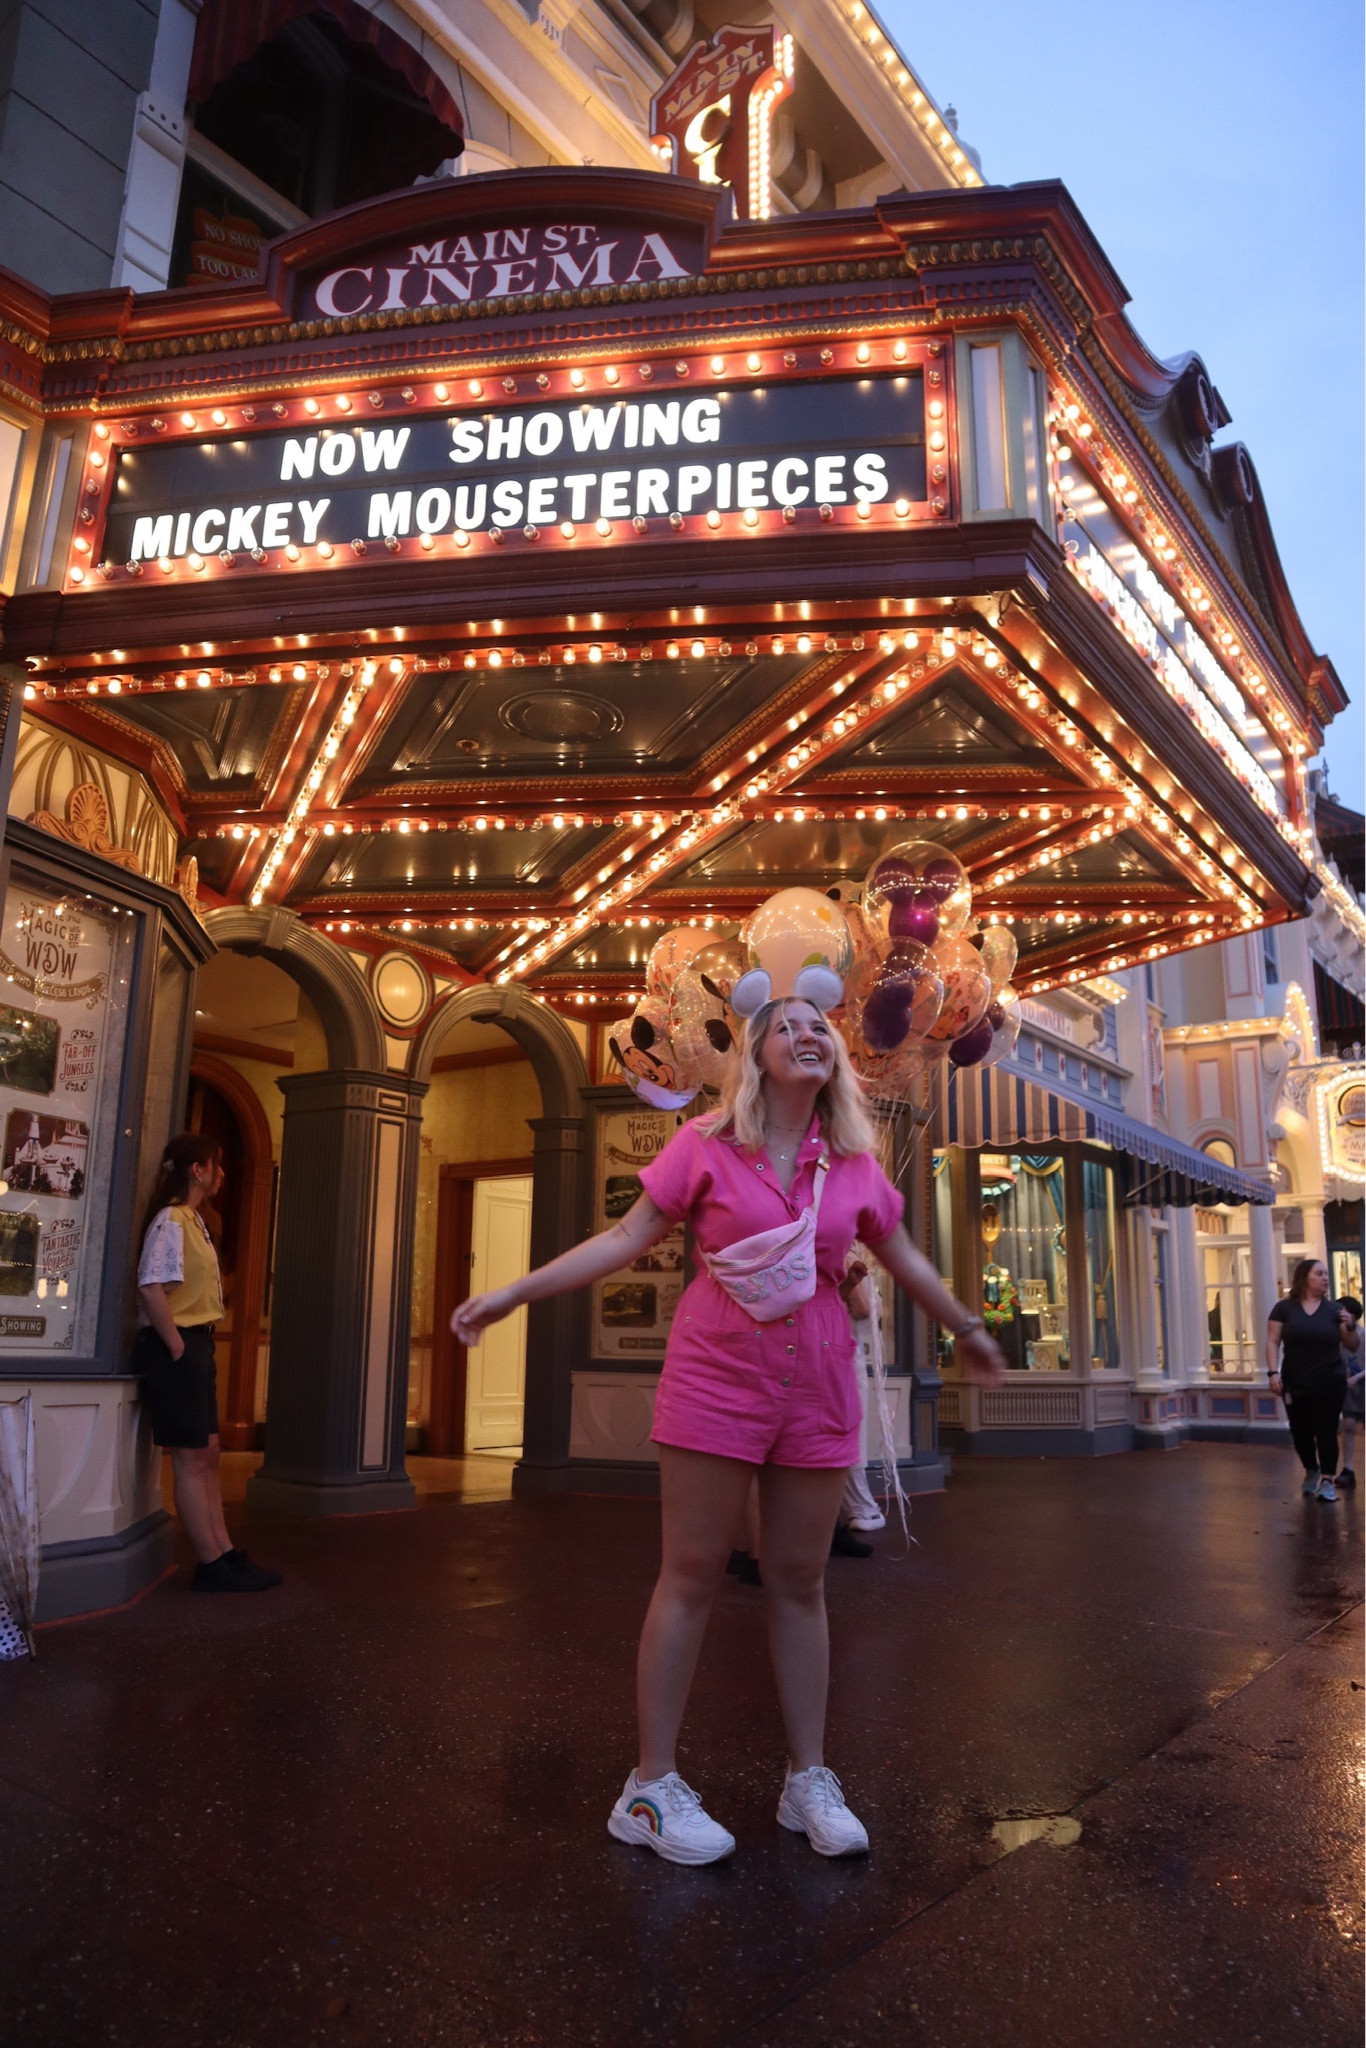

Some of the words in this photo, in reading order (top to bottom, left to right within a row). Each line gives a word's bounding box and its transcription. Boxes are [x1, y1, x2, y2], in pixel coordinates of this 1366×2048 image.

[204, 222, 226, 242] NO
[407, 227, 533, 266] MAIN
[541, 224, 602, 253] ST.
[198, 255, 230, 278] TOO
[314, 231, 694, 319] CINEMA
[279, 426, 412, 481] NOW
[448, 397, 721, 463] SHOWING
[129, 498, 332, 561] MICKEY
[366, 452, 890, 539] MOUSETERPIECES
[20, 902, 67, 940] MAGIC
[23, 932, 78, 981] WDW
[62, 1043, 98, 1062] FAR-OFF
[59, 1061, 95, 1081] JUNGLES
[626, 1119, 658, 1137] MAGIC
[630, 1133, 666, 1153] WDW
[41, 1231, 81, 1256] FANTASTIC
[42, 1252, 75, 1276] VOYAGES
[733, 1253, 811, 1305] LYDS
[0, 1317, 42, 1335] SHOWING
